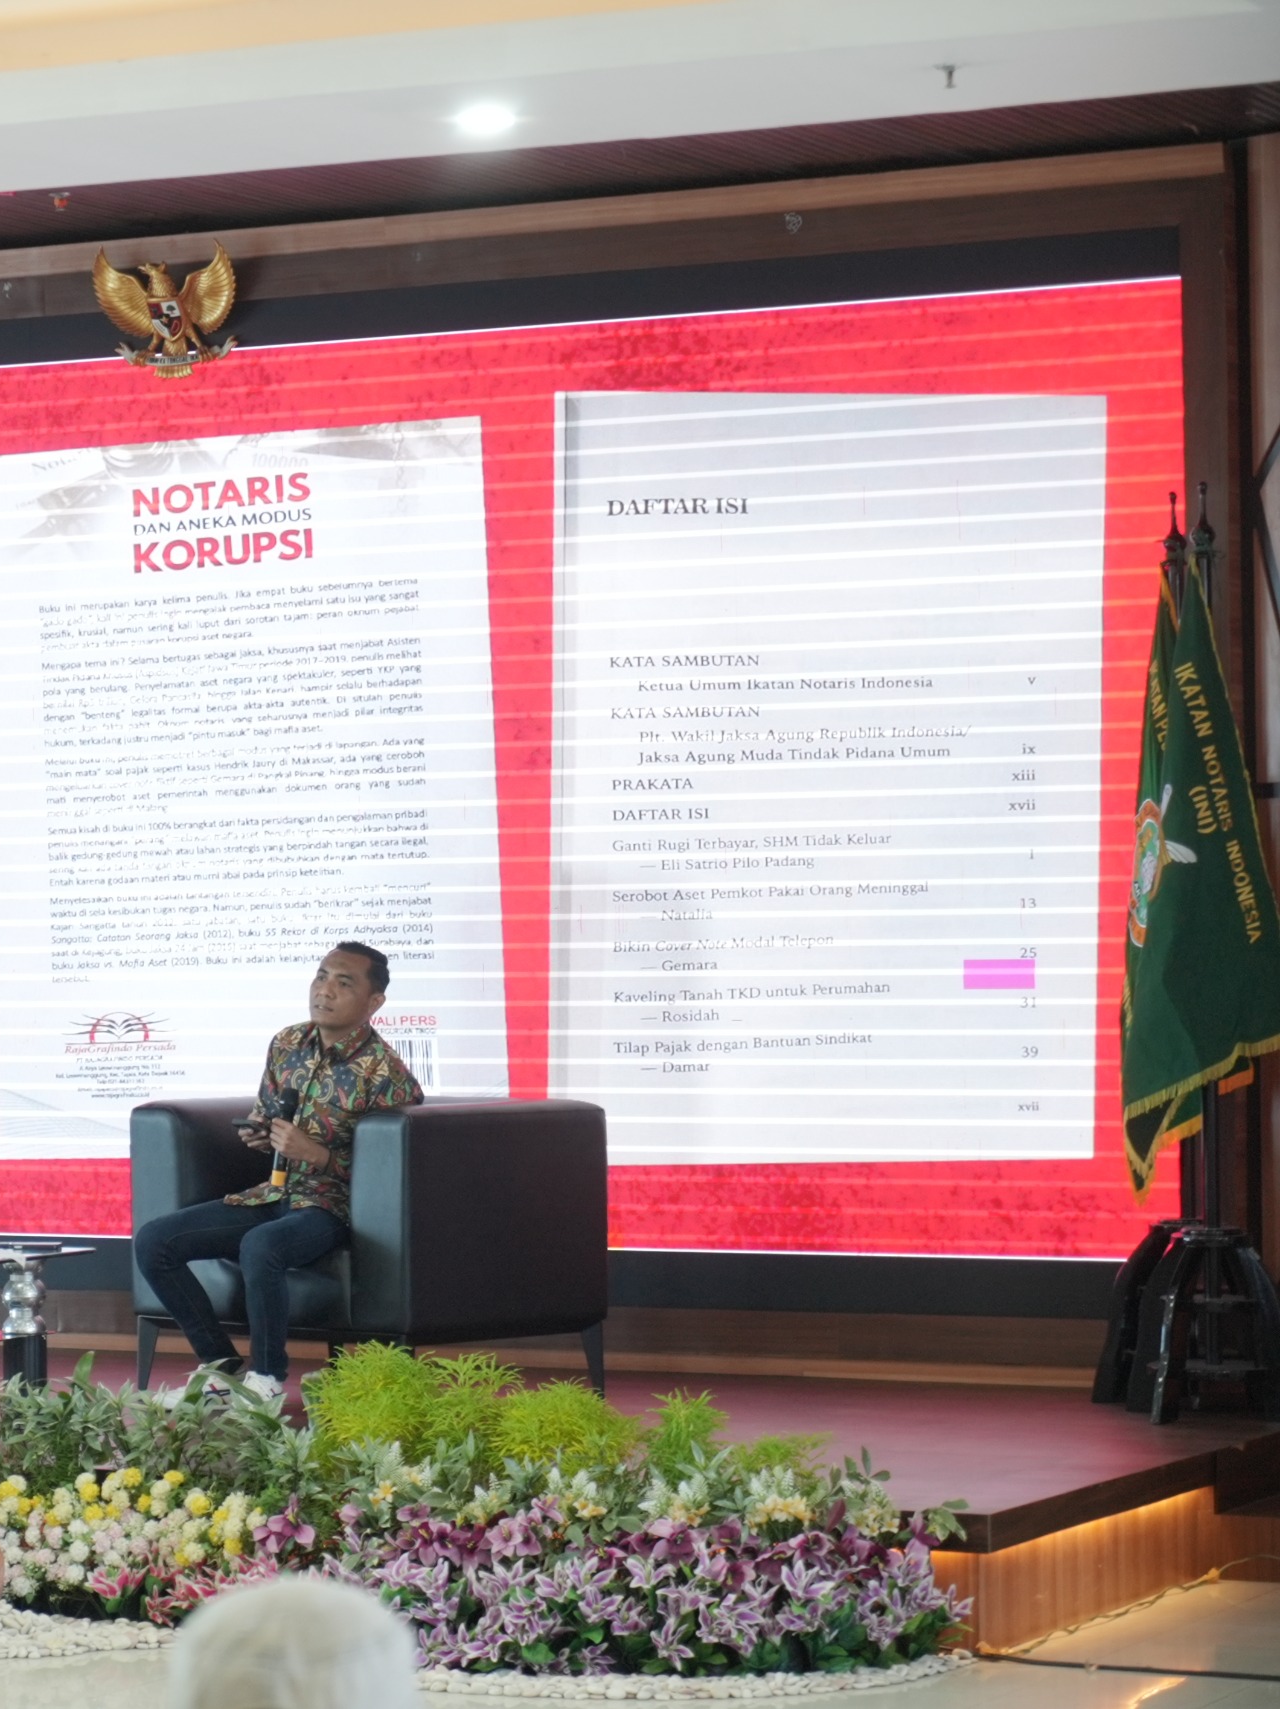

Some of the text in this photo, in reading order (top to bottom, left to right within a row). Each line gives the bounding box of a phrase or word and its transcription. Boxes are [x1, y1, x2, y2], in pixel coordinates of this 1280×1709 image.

[133, 472, 310, 517] NOTARIS
[607, 497, 747, 515] DAFTAR ISI
[134, 508, 312, 536] DAN ANEKA MODUS
[134, 529, 313, 573] KORUPSI
[610, 655, 758, 667] KATA SAMBUTAN
[638, 676, 1036, 691] Ketua Umum Ikatan Notaris Indonesia v
[611, 706, 759, 719] KATA SAMBUTAN
[639, 725, 971, 743] Plt. Wakil Jaksa Agung Republik Indonesia/
[637, 743, 1036, 765] Jaksa Agung Muda Tindak Pidana Umum ix
[612, 770, 1036, 790] PRAKATA xiii
[613, 799, 1036, 820] DAFTAR ISI xvii
[1173, 662, 1262, 944] IKATAN NOTARIS INDONESIA
[1188, 785, 1217, 835] (INI)
[612, 833, 891, 853] Ganti Rugi Terbayar, SHM Tidak Keluar
[661, 859, 680, 870] Eli
[684, 859, 728, 869] Satrio
[732, 857, 760, 868] Pilo
[764, 856, 814, 868] Padang
[612, 882, 928, 902] Serobot Aset Pemkot Pakai Orang Meninggal
[1020, 897, 1037, 909] 13
[661, 947, 1037, 971] Gemara 25
[613, 982, 889, 1004] Kaveling Tanah TKD untuk Perumahan
[662, 996, 1037, 1022] Rosidah 31
[400, 1016, 436, 1025] PERS
[65, 1042, 176, 1055] RajaGrafindo Persada
[613, 1032, 871, 1056] Tilap Pajak dengan Bantuan Sindikat
[662, 1046, 1039, 1072] Damar 39
[1017, 1101, 1039, 1112] xvii
